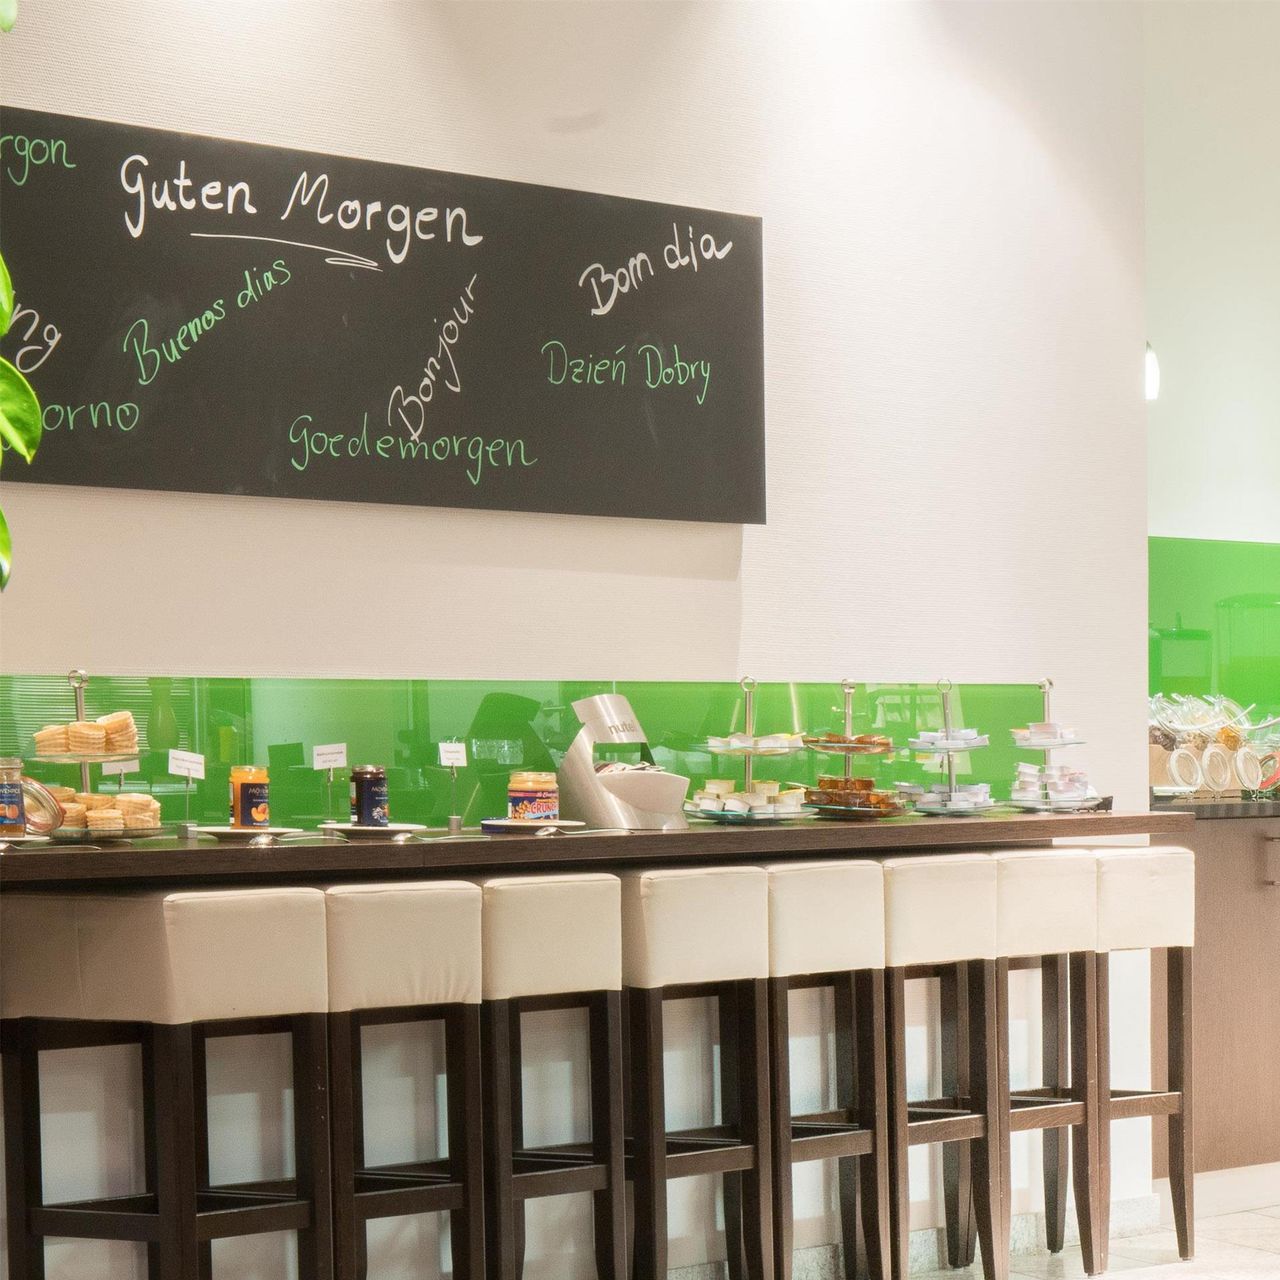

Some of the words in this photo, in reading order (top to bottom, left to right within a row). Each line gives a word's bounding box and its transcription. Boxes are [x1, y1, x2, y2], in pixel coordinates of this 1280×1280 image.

[119, 153, 258, 239] Guten
[280, 170, 484, 265] Morgen
[122, 298, 227, 386] Buenos
[236, 259, 292, 309] dias
[577, 251, 655, 317] Bom
[387, 273, 478, 444] Bonjour
[540, 340, 627, 386] Dzień
[637, 343, 711, 406] Dobry
[288, 411, 539, 486] Goedemorgen
